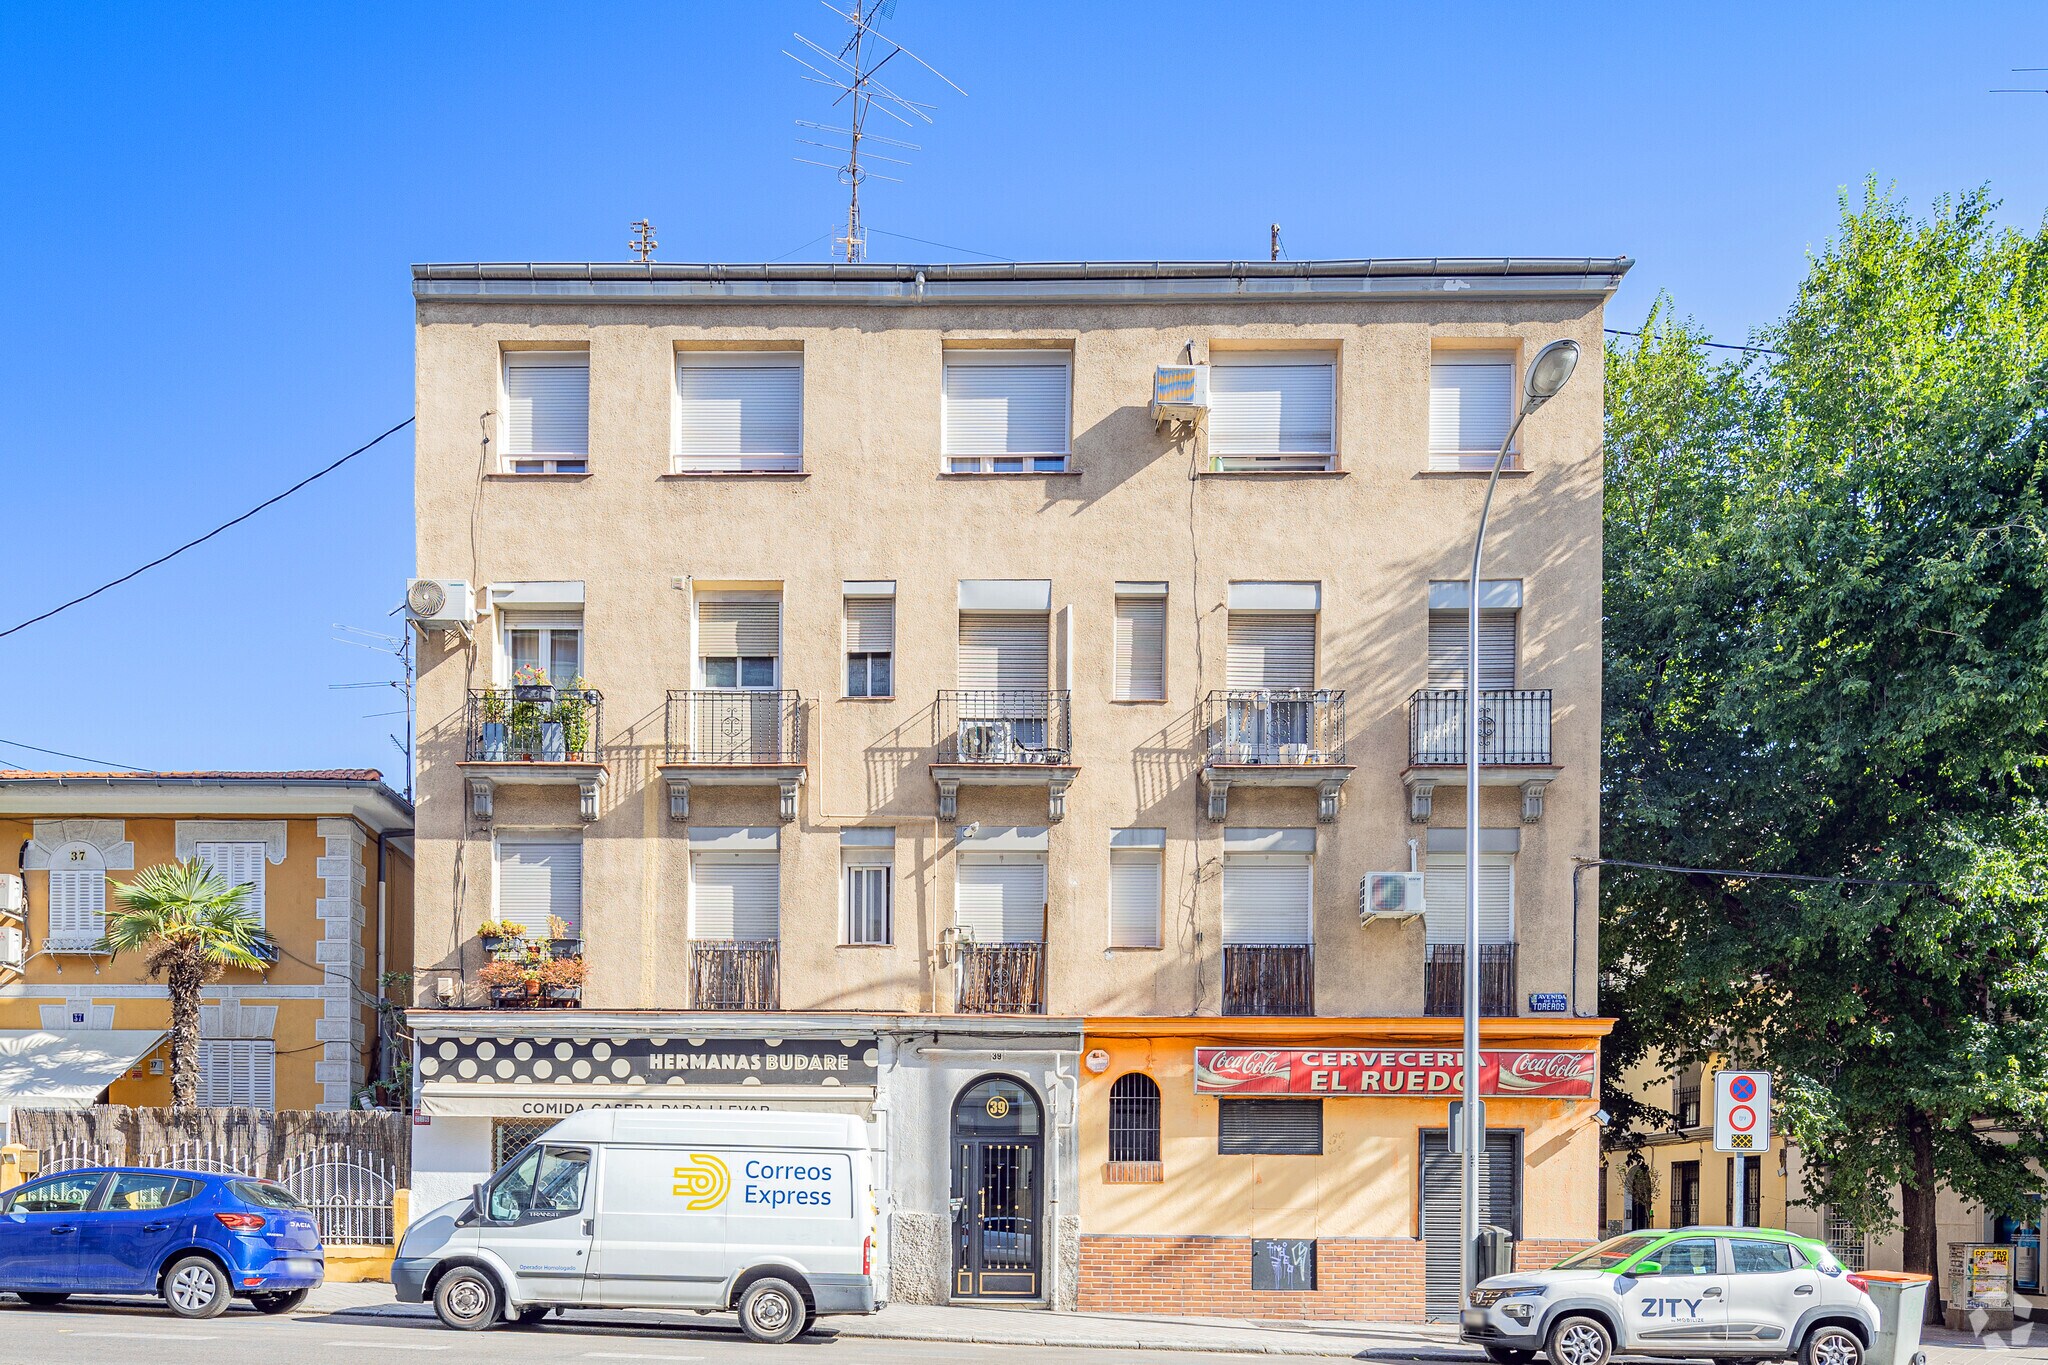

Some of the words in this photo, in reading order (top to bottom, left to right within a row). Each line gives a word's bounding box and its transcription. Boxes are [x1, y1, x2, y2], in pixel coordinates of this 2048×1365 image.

[71, 851, 85, 861] 37
[1532, 1002, 1565, 1011] TOREROS
[649, 1053, 761, 1070] HERMANAS
[765, 1054, 849, 1071] BUDARE
[992, 1052, 1002, 1060] 39
[1208, 1050, 1281, 1075] Coca-Cola
[1511, 1052, 1586, 1077] Coca-Cola
[1311, 1070, 1348, 1091] EL
[522, 1102, 585, 1114] COMIDA
[989, 1100, 1006, 1114] 39
[745, 1160, 832, 1181] Correos
[745, 1184, 832, 1209] Express
[544, 1264, 577, 1272] Homologado
[1641, 1298, 1703, 1318] ZITY
